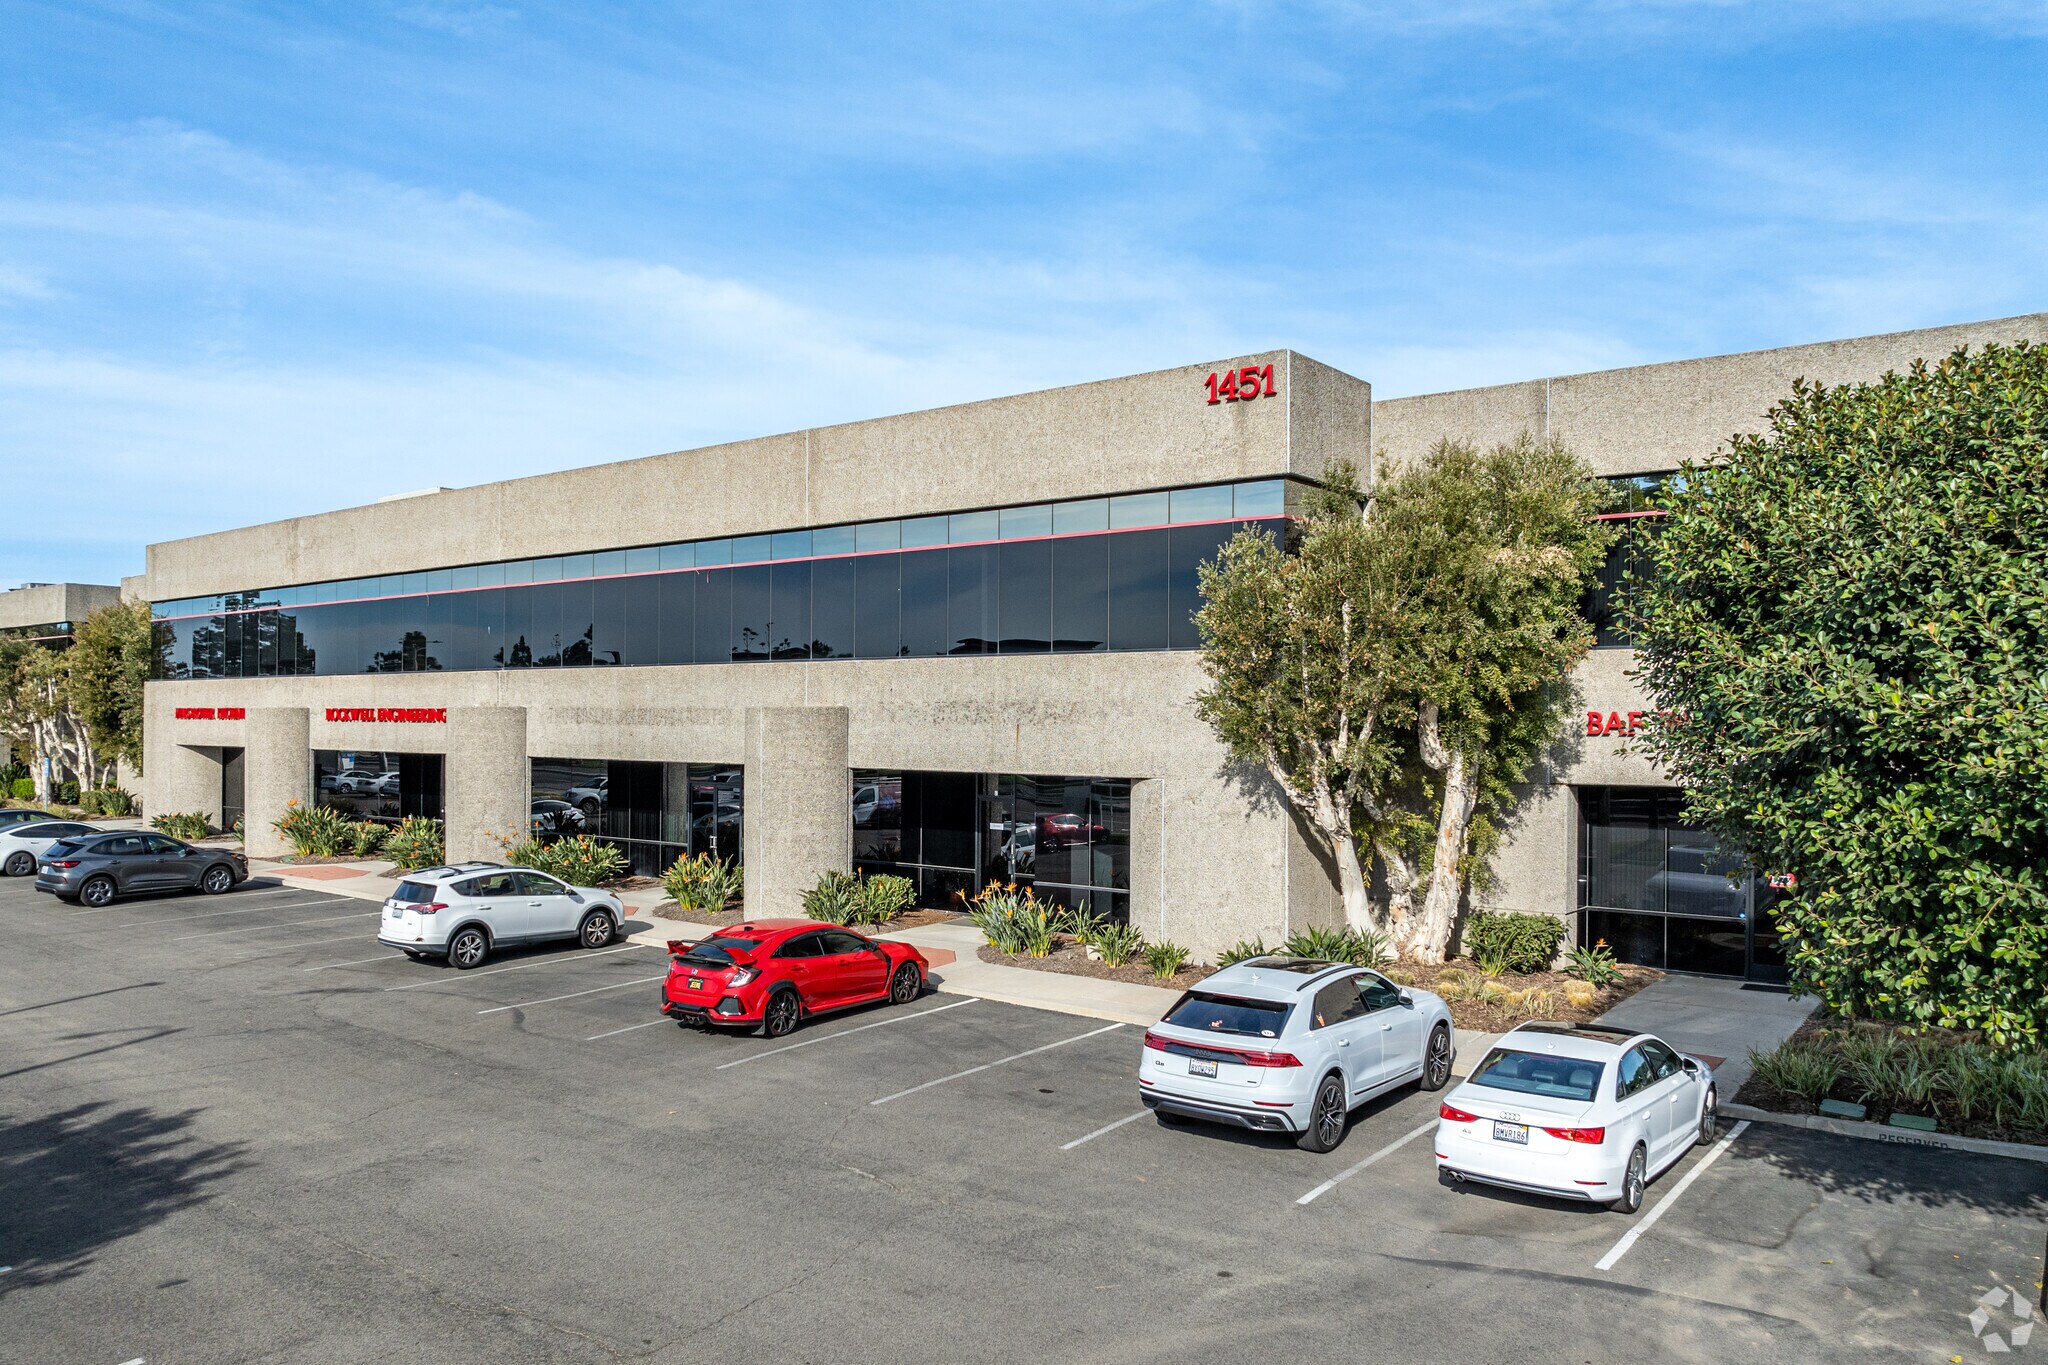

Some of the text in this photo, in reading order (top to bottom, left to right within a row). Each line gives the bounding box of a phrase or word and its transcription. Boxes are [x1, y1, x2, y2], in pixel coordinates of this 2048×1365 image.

[1204, 363, 1275, 403] 1451
[325, 708, 447, 722] ROCKWELL ENGINEERING
